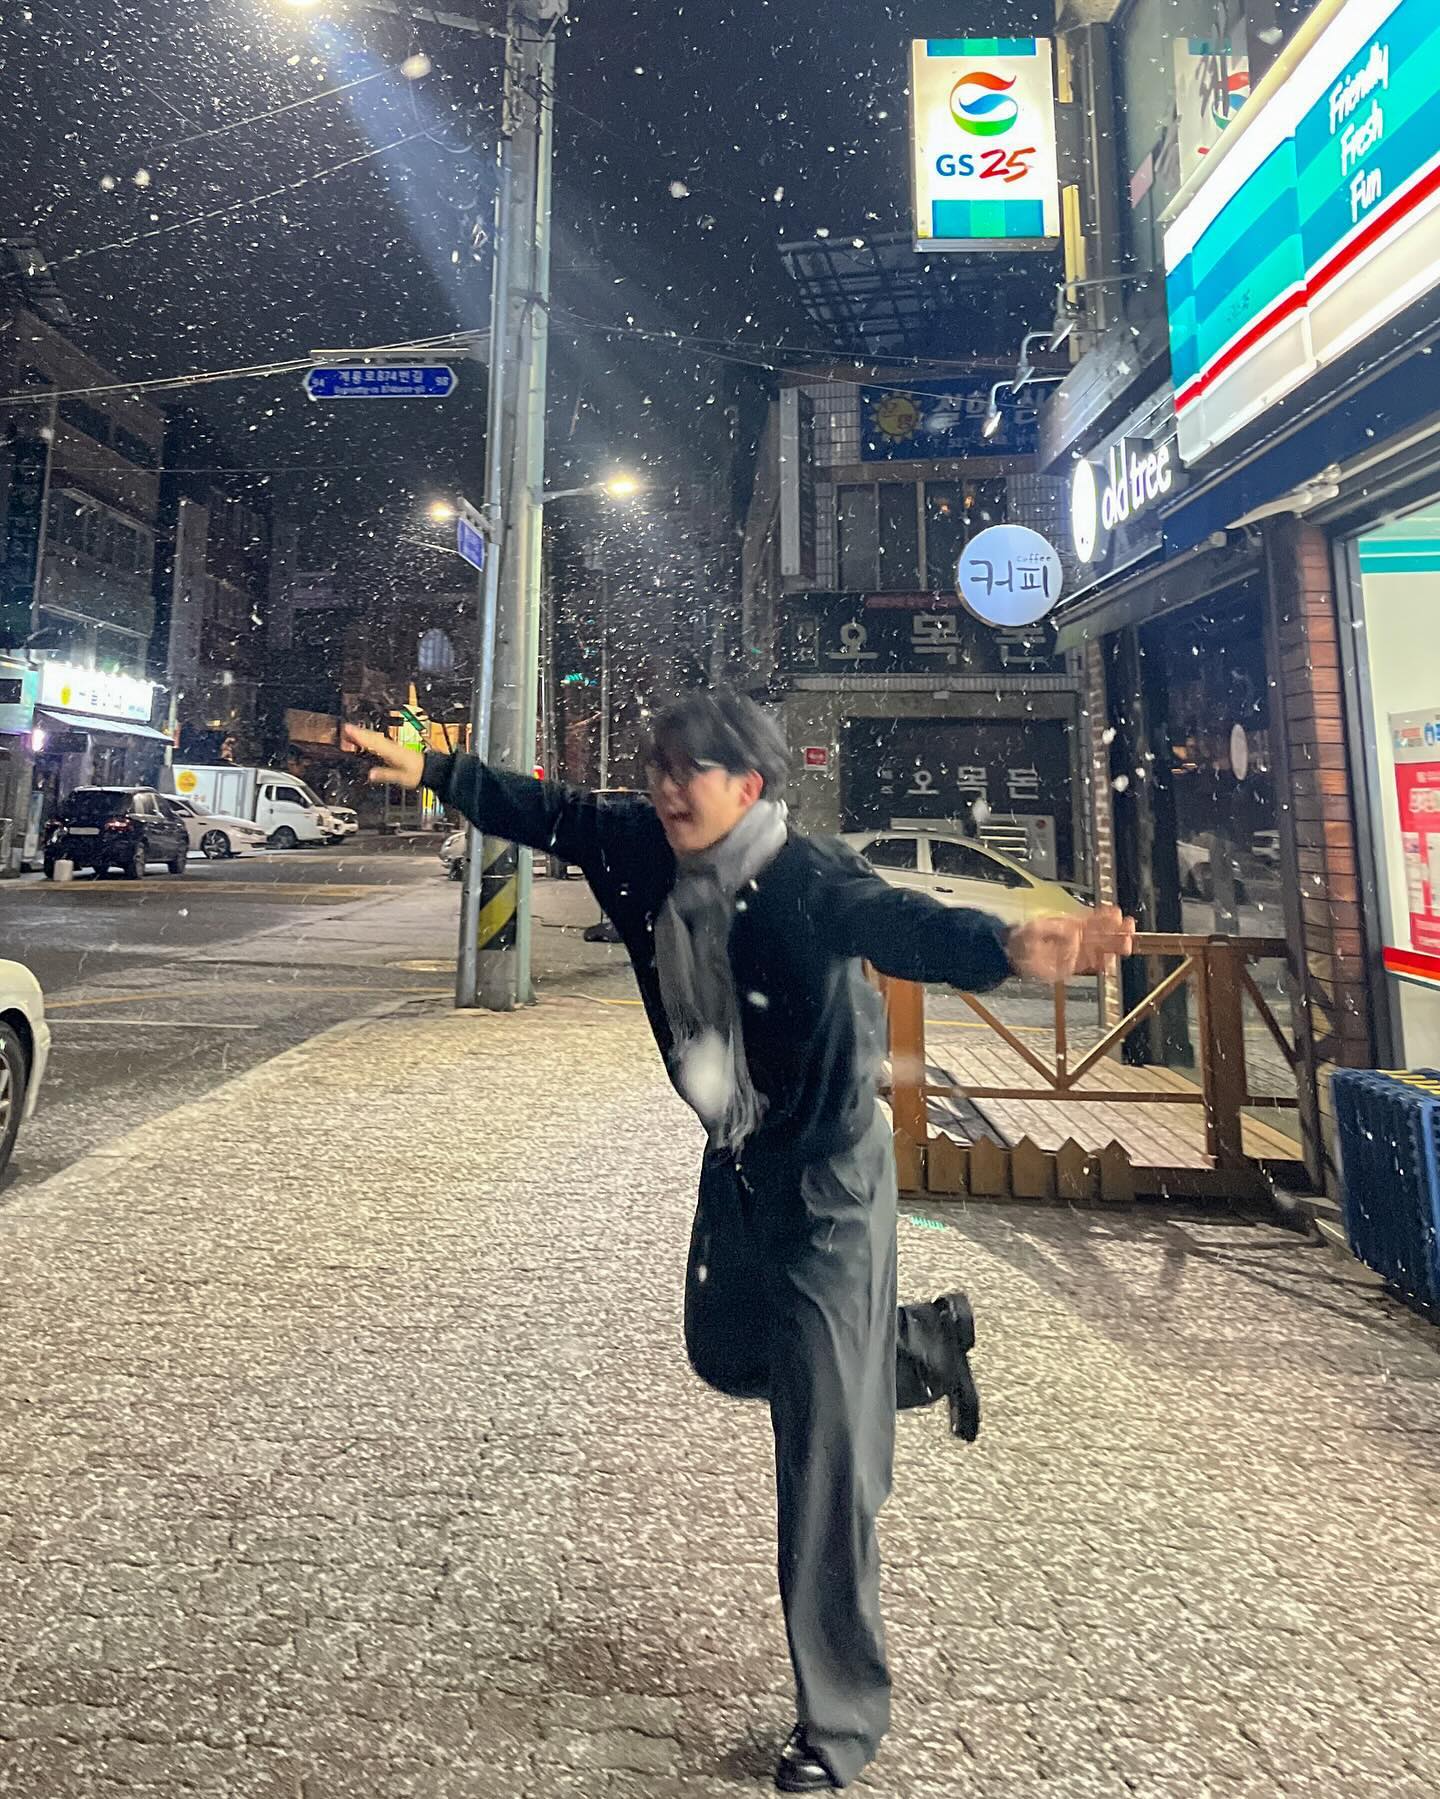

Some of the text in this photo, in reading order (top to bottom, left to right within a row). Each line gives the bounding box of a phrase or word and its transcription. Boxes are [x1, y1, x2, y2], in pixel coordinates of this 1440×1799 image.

[1328, 41, 1389, 134] Friendly
[935, 146, 1037, 183] GS25
[1340, 99, 1383, 176] Fresh
[1350, 168, 1381, 223] Fun
[1101, 438, 1172, 530] old tree
[969, 559, 1050, 598] 커피
[1017, 552, 1051, 563] coffee
